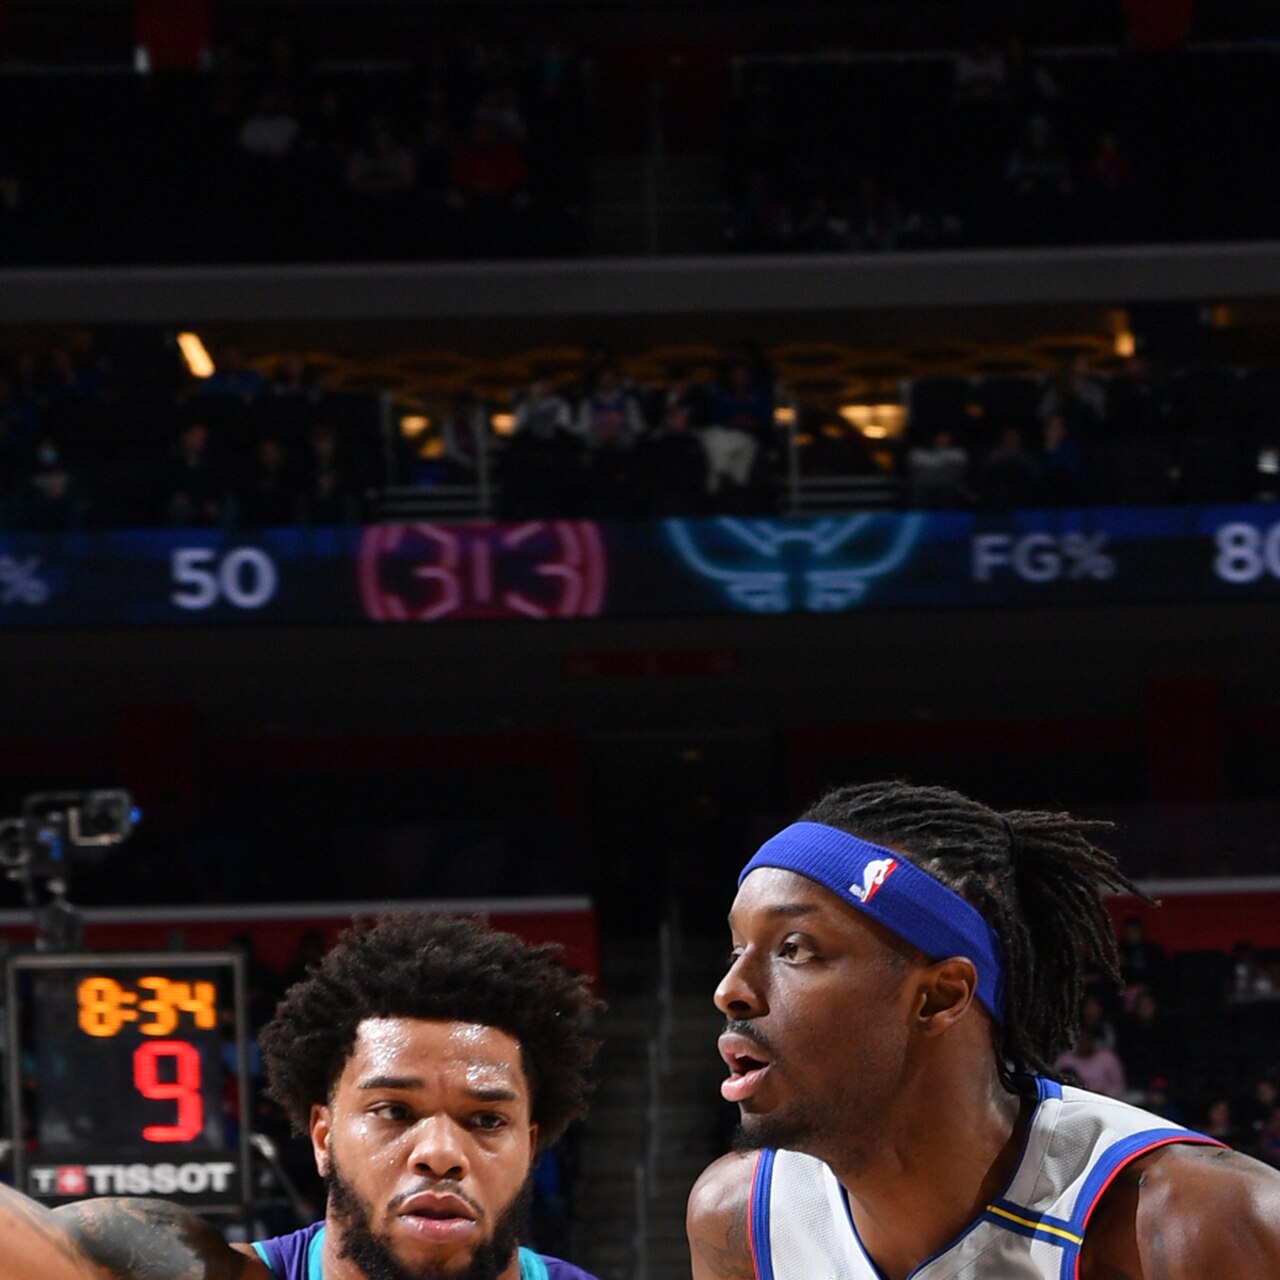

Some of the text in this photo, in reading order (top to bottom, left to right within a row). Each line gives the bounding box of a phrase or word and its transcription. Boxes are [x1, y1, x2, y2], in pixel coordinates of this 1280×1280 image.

[169, 546, 278, 610] 50
[970, 531, 1118, 583] FG%
[77, 976, 216, 1037] 8:34
[132, 1039, 203, 1144] 9
[86, 1161, 235, 1194] TISSOT
